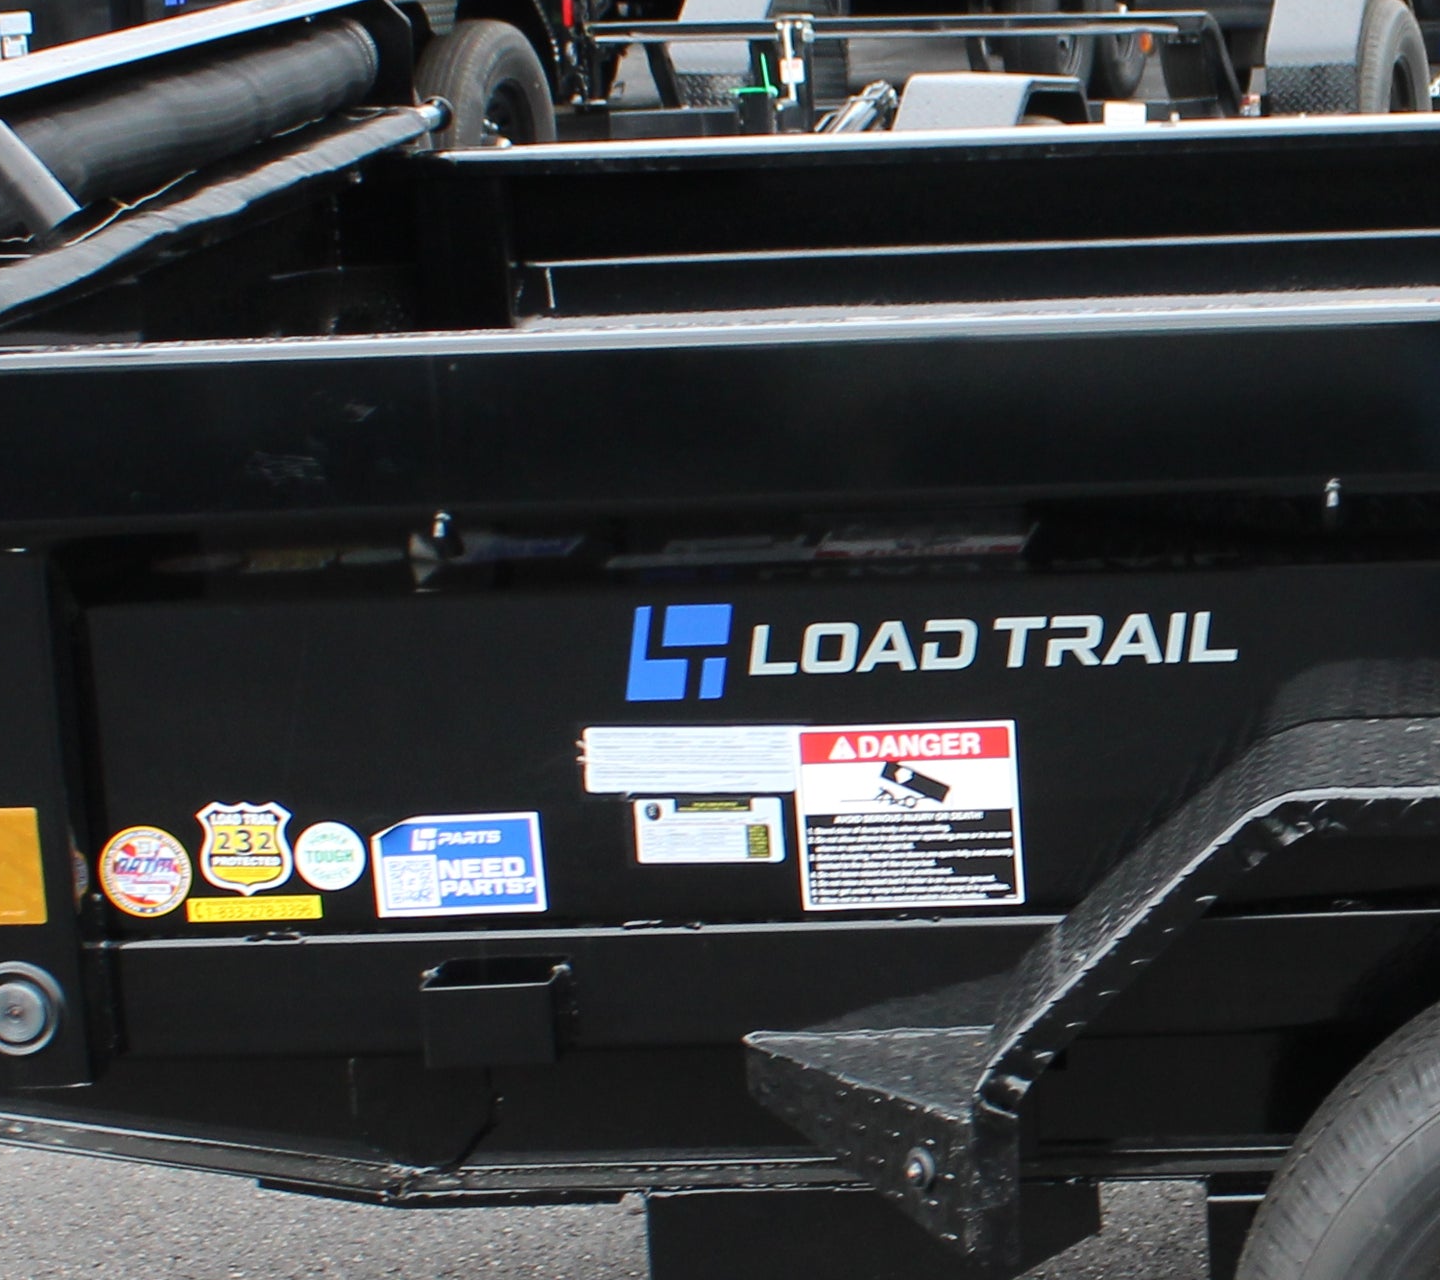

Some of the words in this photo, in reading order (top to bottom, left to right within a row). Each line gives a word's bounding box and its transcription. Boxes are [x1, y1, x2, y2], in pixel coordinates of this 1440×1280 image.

[748, 617, 979, 677] LOAD
[993, 610, 1239, 669] TRAIL
[858, 732, 981, 759] DANGER
[210, 813, 242, 826] LOAD
[244, 813, 278, 826] TRAIL
[217, 830, 272, 855] 232
[438, 830, 502, 846] PARTS
[211, 856, 282, 867] PROTECTED
[304, 848, 355, 865] TOUGH
[439, 856, 526, 880] NEED
[441, 876, 537, 897] PARTS?
